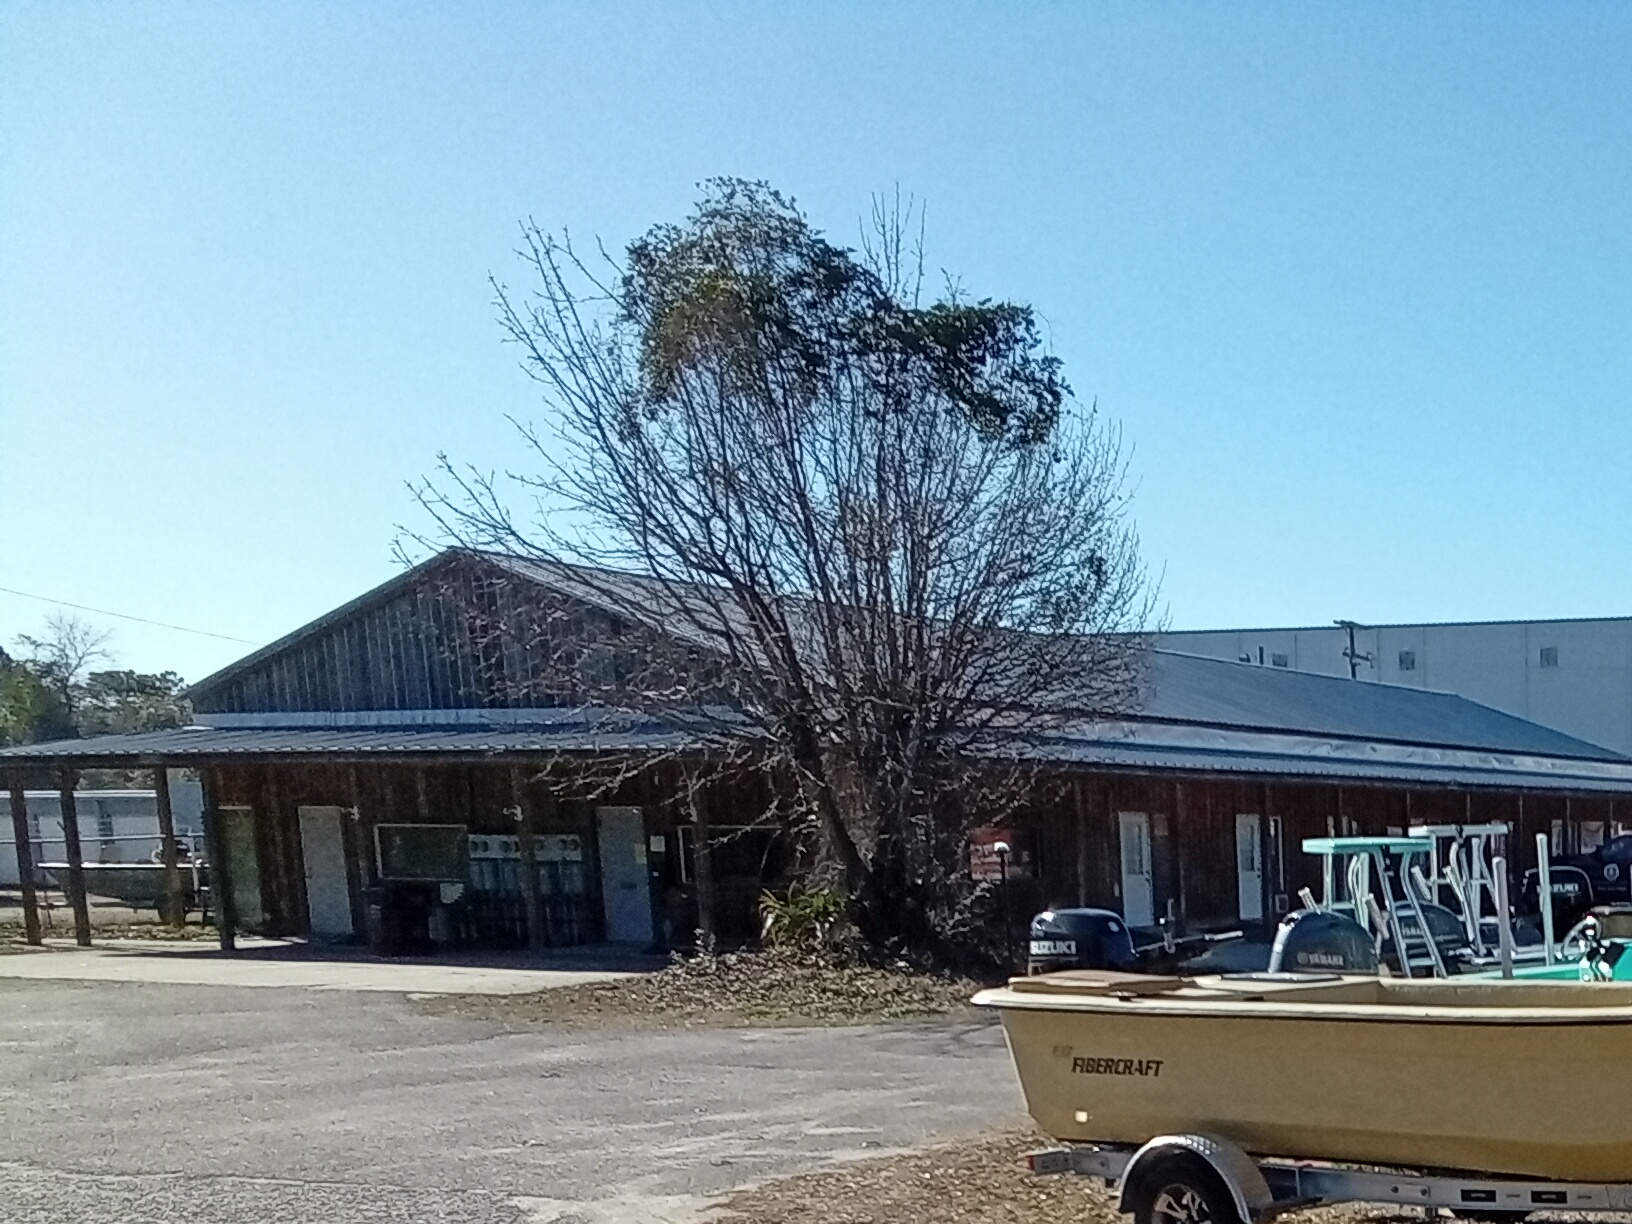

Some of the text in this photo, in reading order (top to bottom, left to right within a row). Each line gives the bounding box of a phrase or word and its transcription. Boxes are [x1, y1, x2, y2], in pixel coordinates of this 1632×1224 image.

[1030, 940, 1077, 955] SUZUKI
[1308, 953, 1345, 966] YAMAHA
[1071, 1056, 1164, 1077] FIBERCRAFT
